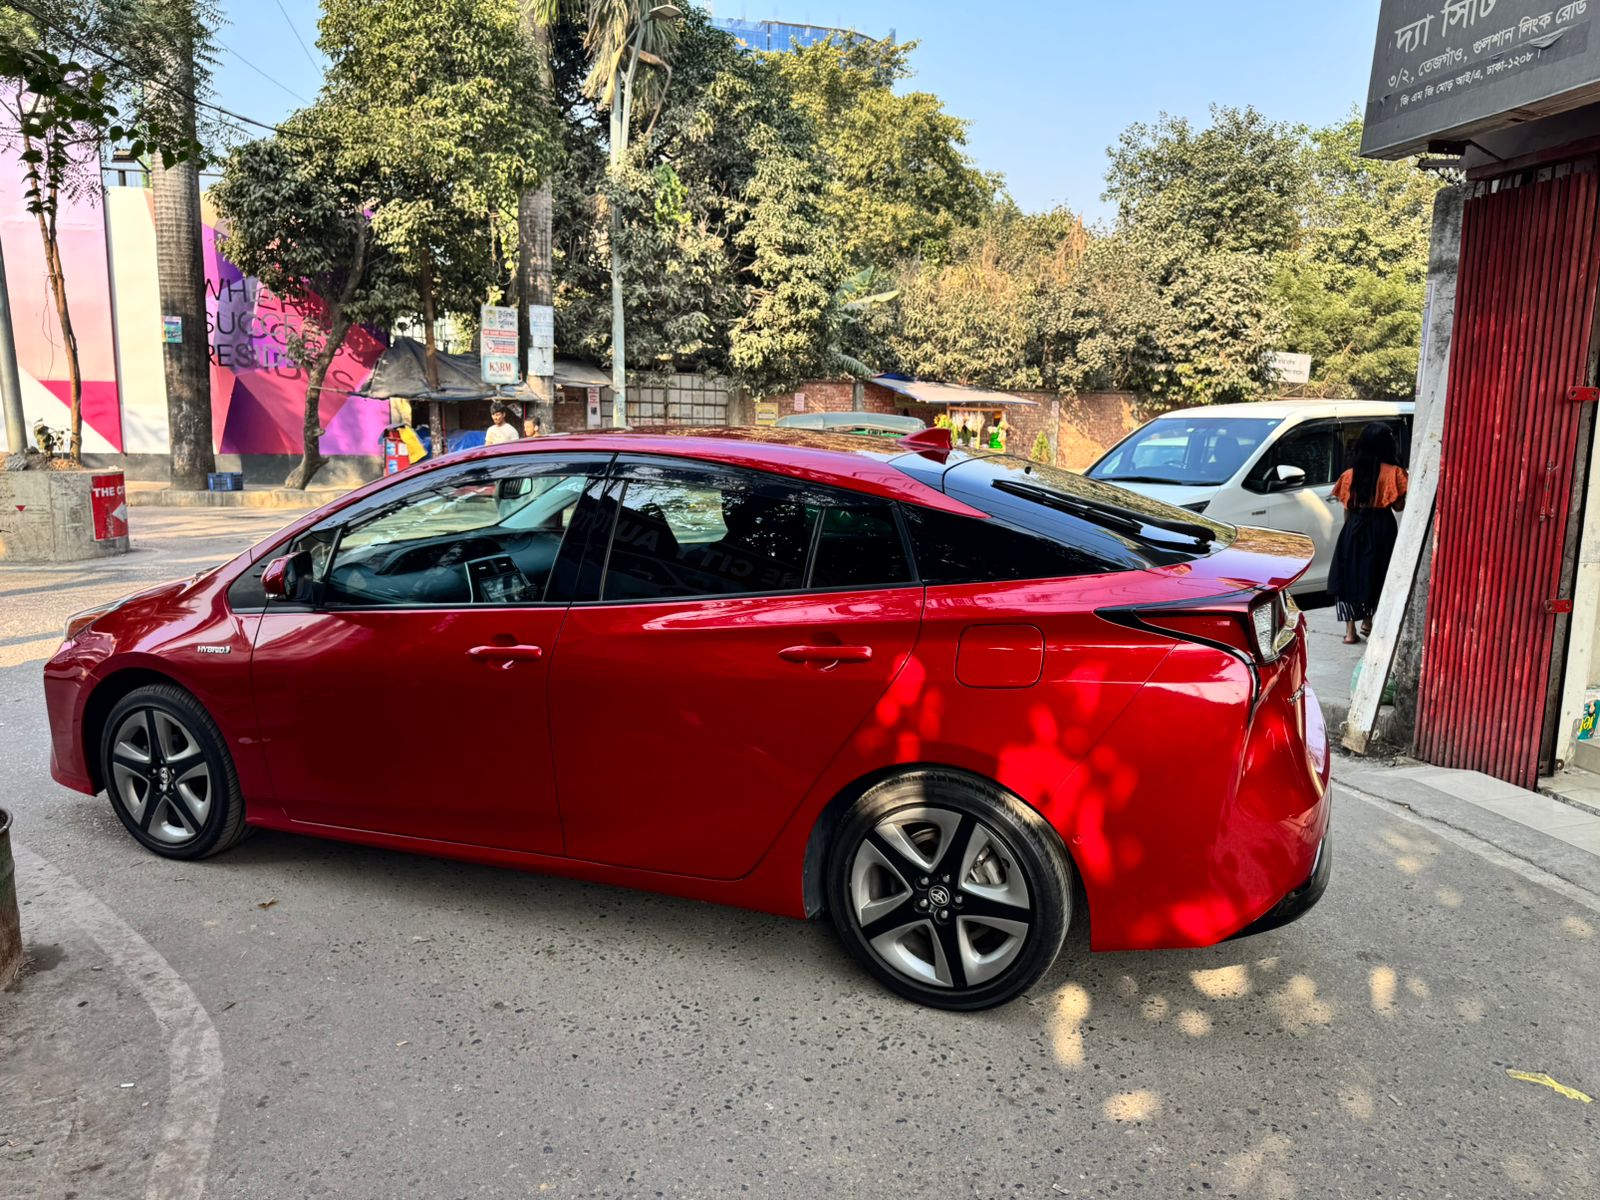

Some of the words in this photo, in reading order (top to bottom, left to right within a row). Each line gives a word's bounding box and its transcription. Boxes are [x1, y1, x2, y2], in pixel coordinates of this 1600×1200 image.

[1394, 13, 1435, 54] দ্যা
[1418, 46, 1467, 77] তেজগাঁও,
[1473, 26, 1516, 54] গুলশান
[1518, 11, 1553, 39] লিংক
[1555, 0, 1587, 24] রোড
[93, 486, 115, 498] THE
